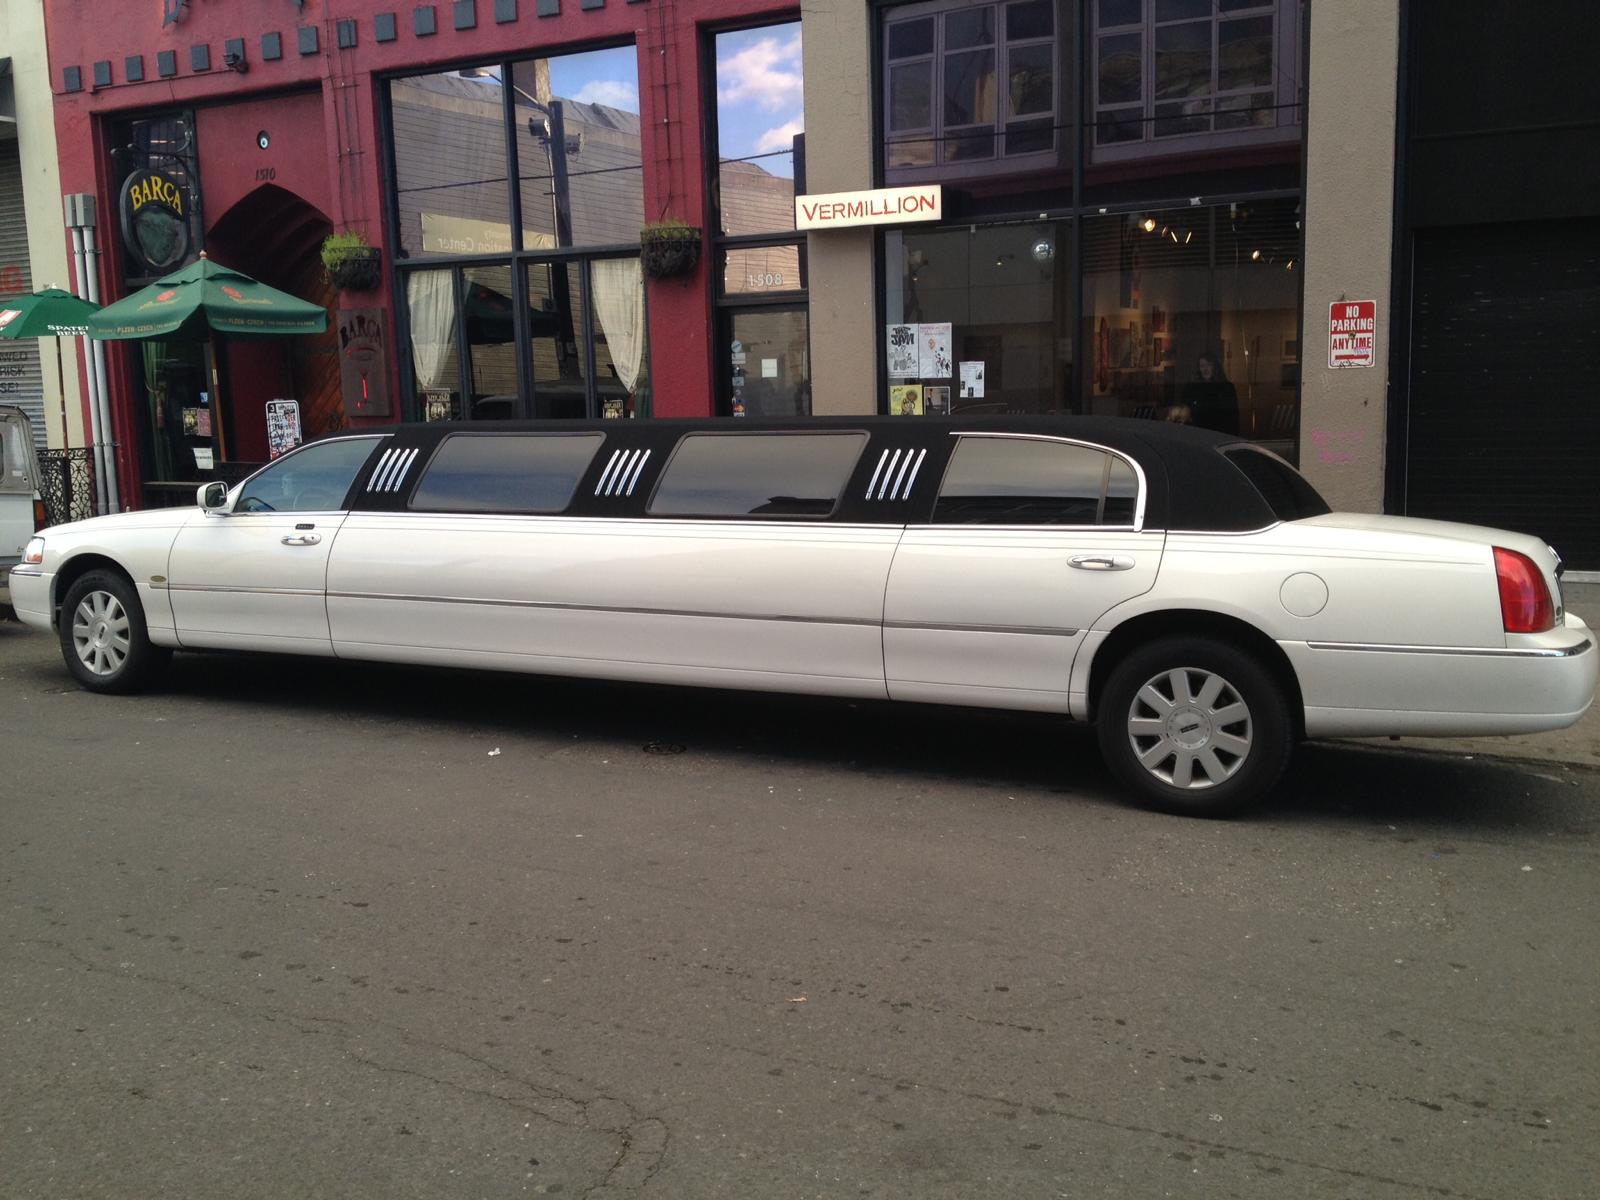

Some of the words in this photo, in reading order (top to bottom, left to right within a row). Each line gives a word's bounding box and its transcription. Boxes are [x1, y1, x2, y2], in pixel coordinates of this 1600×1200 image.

[256, 167, 276, 181] 1510
[129, 175, 183, 216] BARÇA
[802, 194, 935, 221] VERMILLION
[749, 273, 783, 287] 1508
[1345, 305, 1360, 318] NO
[1331, 318, 1374, 331] PARKING
[1332, 337, 1372, 350] ANYTIME
